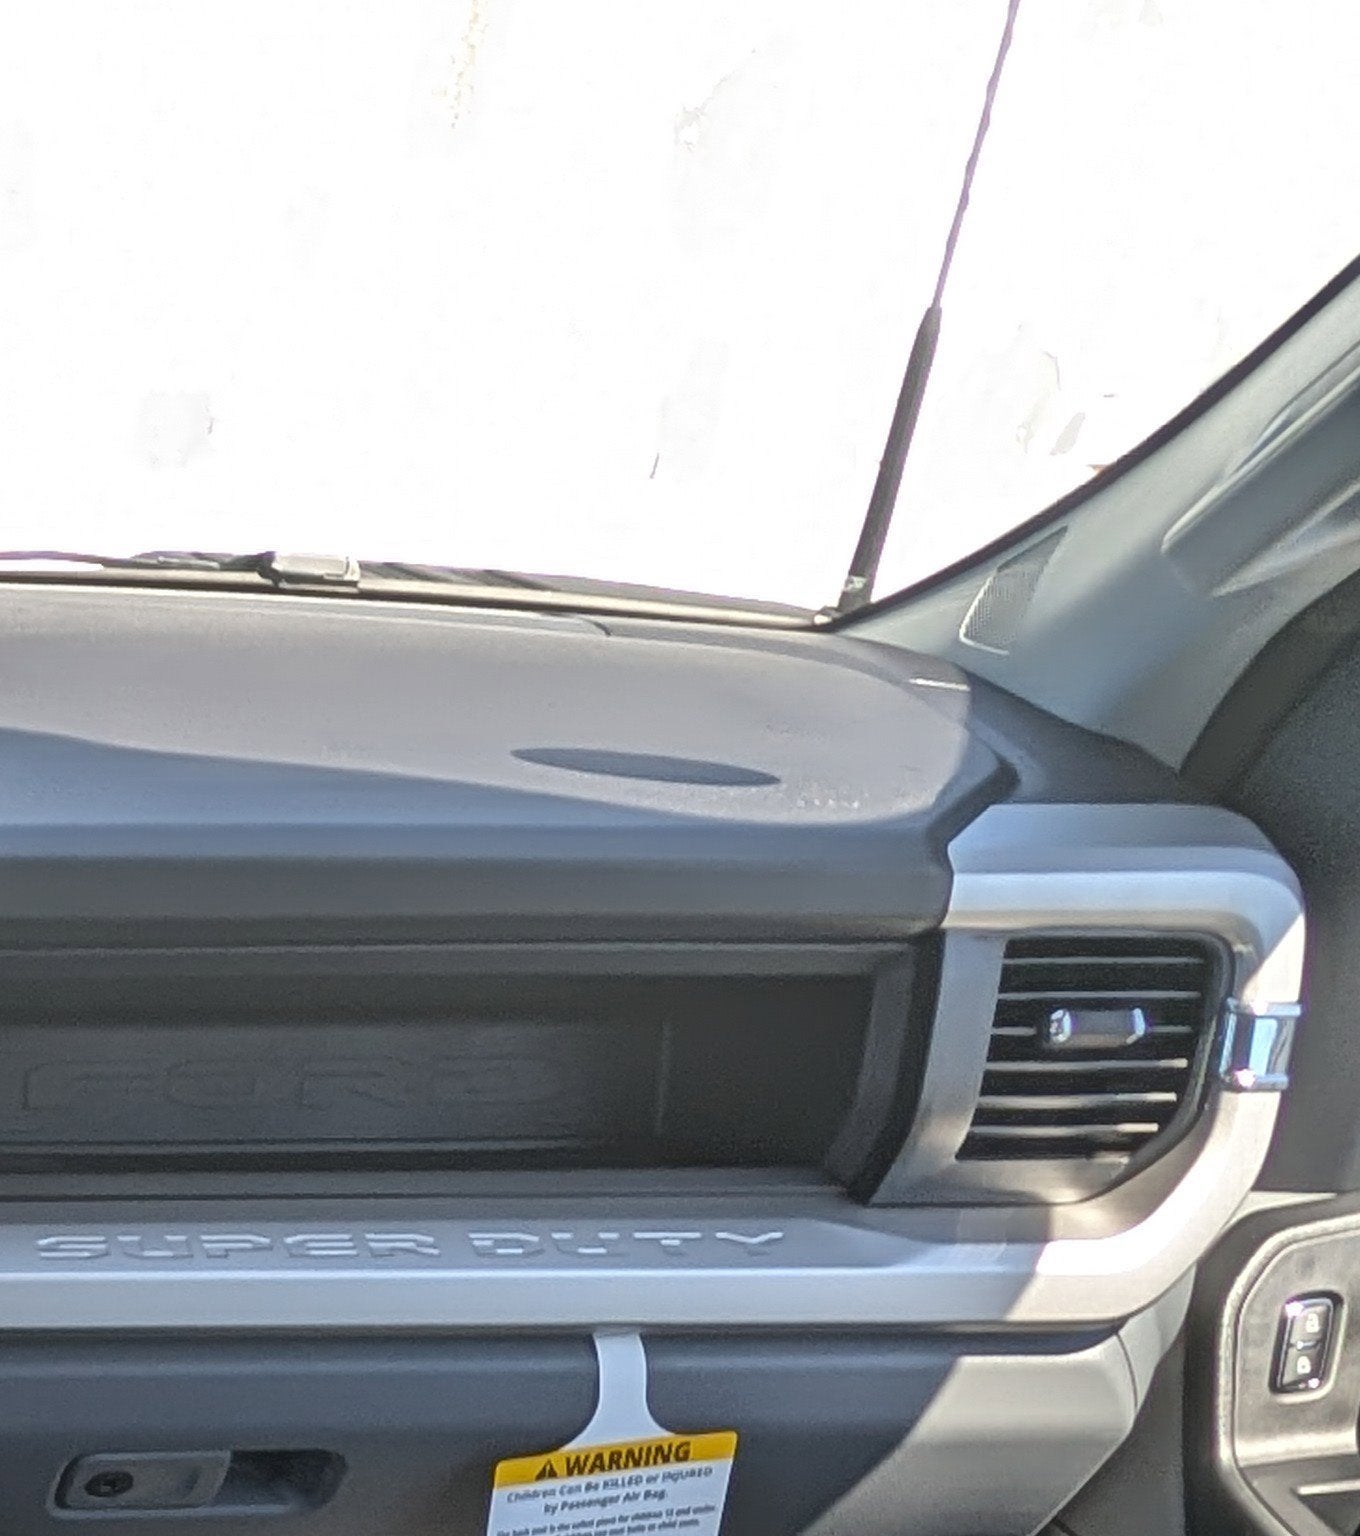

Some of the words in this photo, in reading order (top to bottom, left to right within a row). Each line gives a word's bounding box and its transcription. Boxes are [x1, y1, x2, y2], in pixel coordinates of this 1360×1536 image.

[36, 1233, 441, 1259] SUPER
[468, 1232, 784, 1257] DUTY
[565, 1441, 692, 1477] WARNING
[506, 1487, 557, 1504] Children
[559, 1484, 583, 1497] Can
[584, 1481, 600, 1492] Be
[602, 1475, 643, 1491] KILLED
[560, 1494, 622, 1512] Passenger
[623, 1490, 642, 1503] Air
